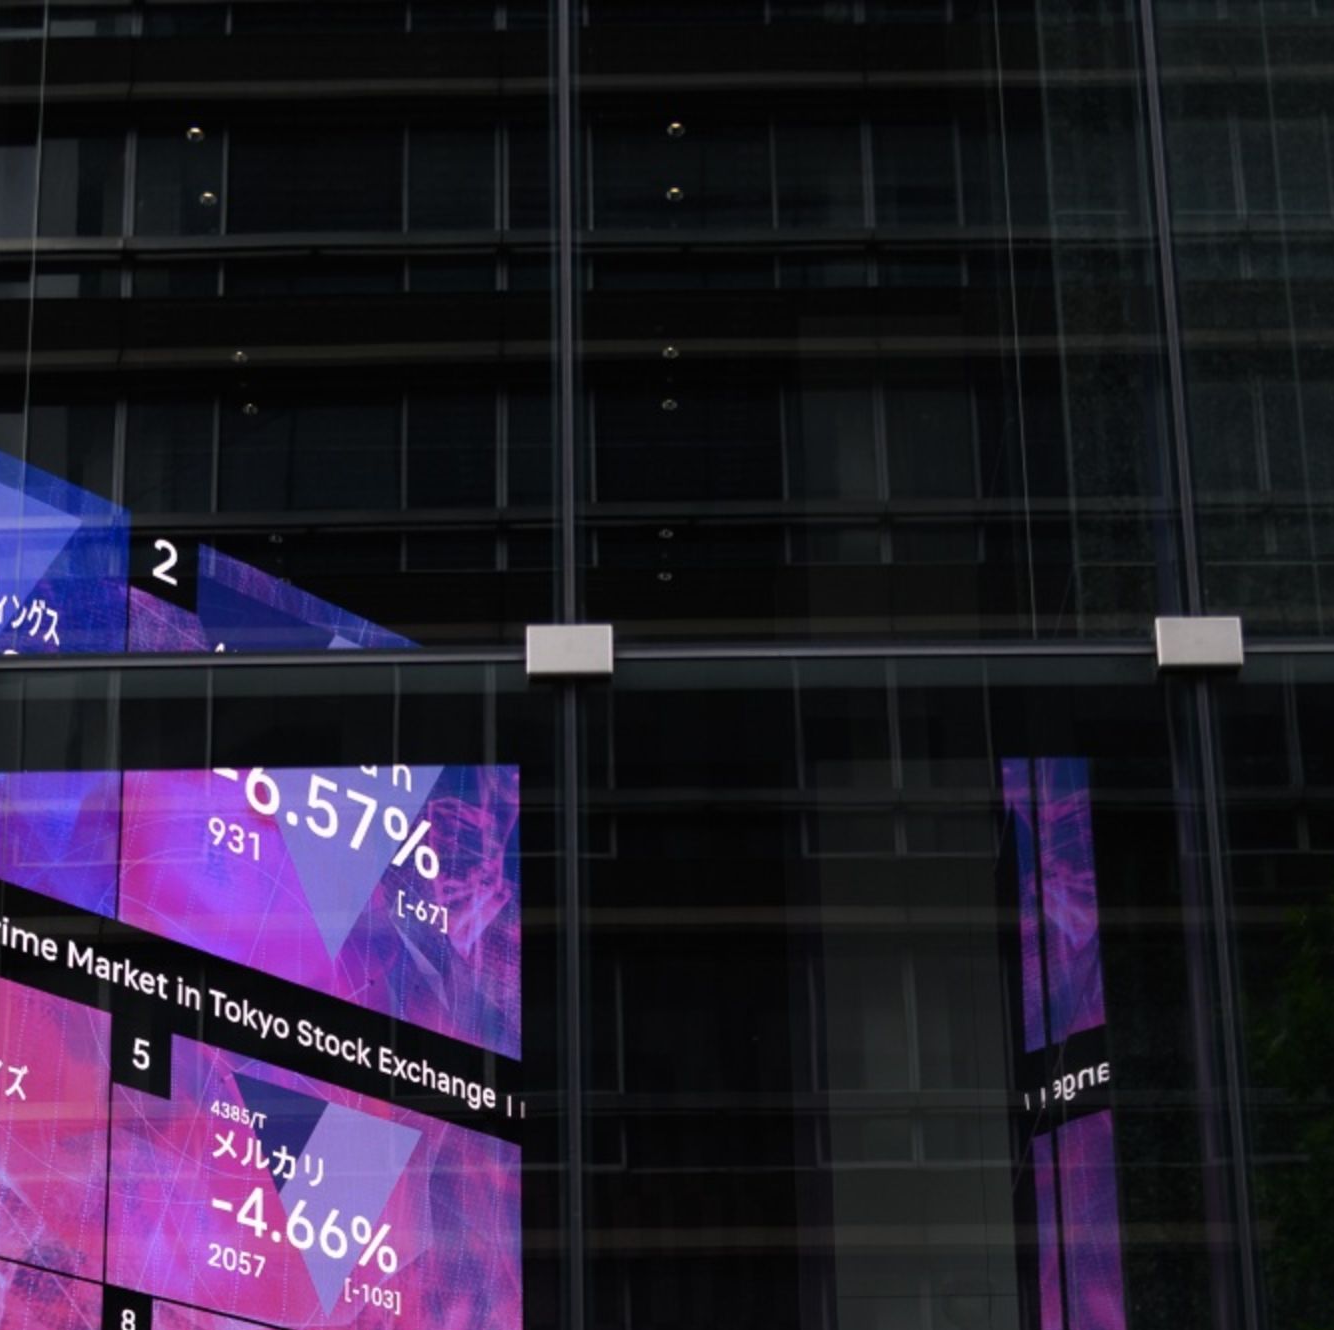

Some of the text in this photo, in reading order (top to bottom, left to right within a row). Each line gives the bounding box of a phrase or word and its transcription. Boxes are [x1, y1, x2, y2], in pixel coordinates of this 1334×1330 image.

[152, 538, 178, 586] 2
[208, 816, 260, 861] 931
[398, 889, 448, 934] [-67]
[67, 939, 169, 1000] Market
[176, 976, 201, 1012] in
[209, 987, 289, 1042] Tokyo
[297, 1020, 371, 1068] Stock
[378, 1046, 497, 1112] Exchange
[132, 1039, 151, 1070] 5
[210, 1100, 267, 1131] 4385/T
[211, 1130, 326, 1187] メルカリ
[211, 1187, 397, 1274] -4.66%
[207, 1243, 266, 1278] 2057
[343, 1280, 402, 1315] [-103]
